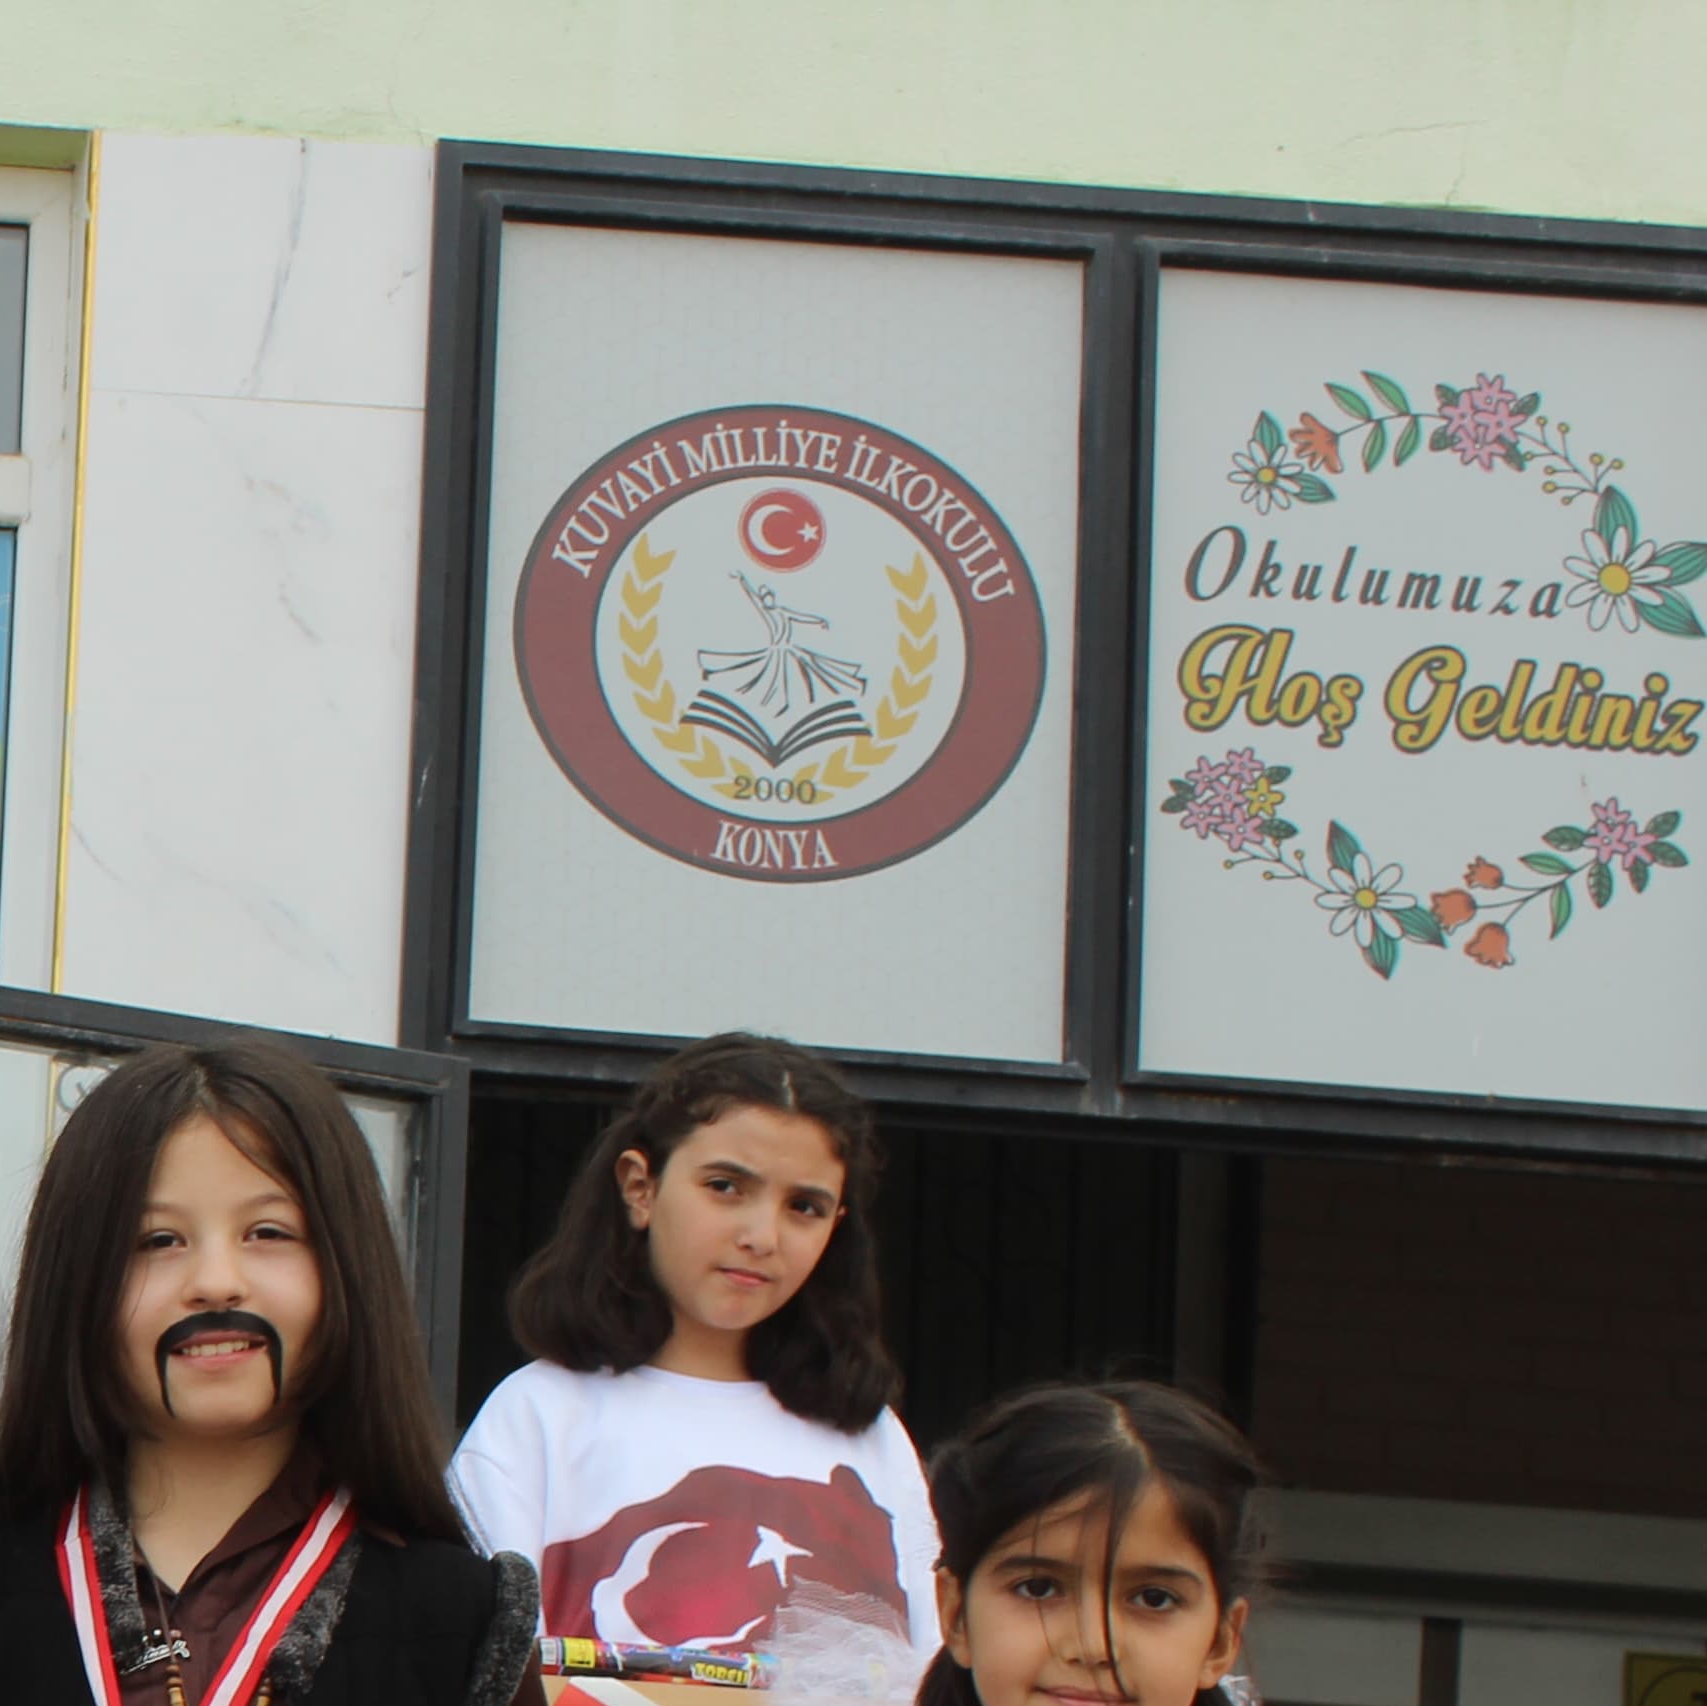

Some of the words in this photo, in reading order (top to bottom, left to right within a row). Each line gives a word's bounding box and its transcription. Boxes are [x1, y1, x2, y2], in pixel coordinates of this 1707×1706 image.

[552, 441, 681, 579] KUVAYİ
[677, 420, 843, 478] MİLLİYE
[845, 434, 1015, 604] İLKOKULU
[1184, 524, 1567, 619] Okulumuza
[1178, 623, 1364, 748] Hoş
[1383, 644, 1704, 756] Geldiniz
[733, 775, 817, 805] 2000
[710, 821, 839, 870] KONYA
